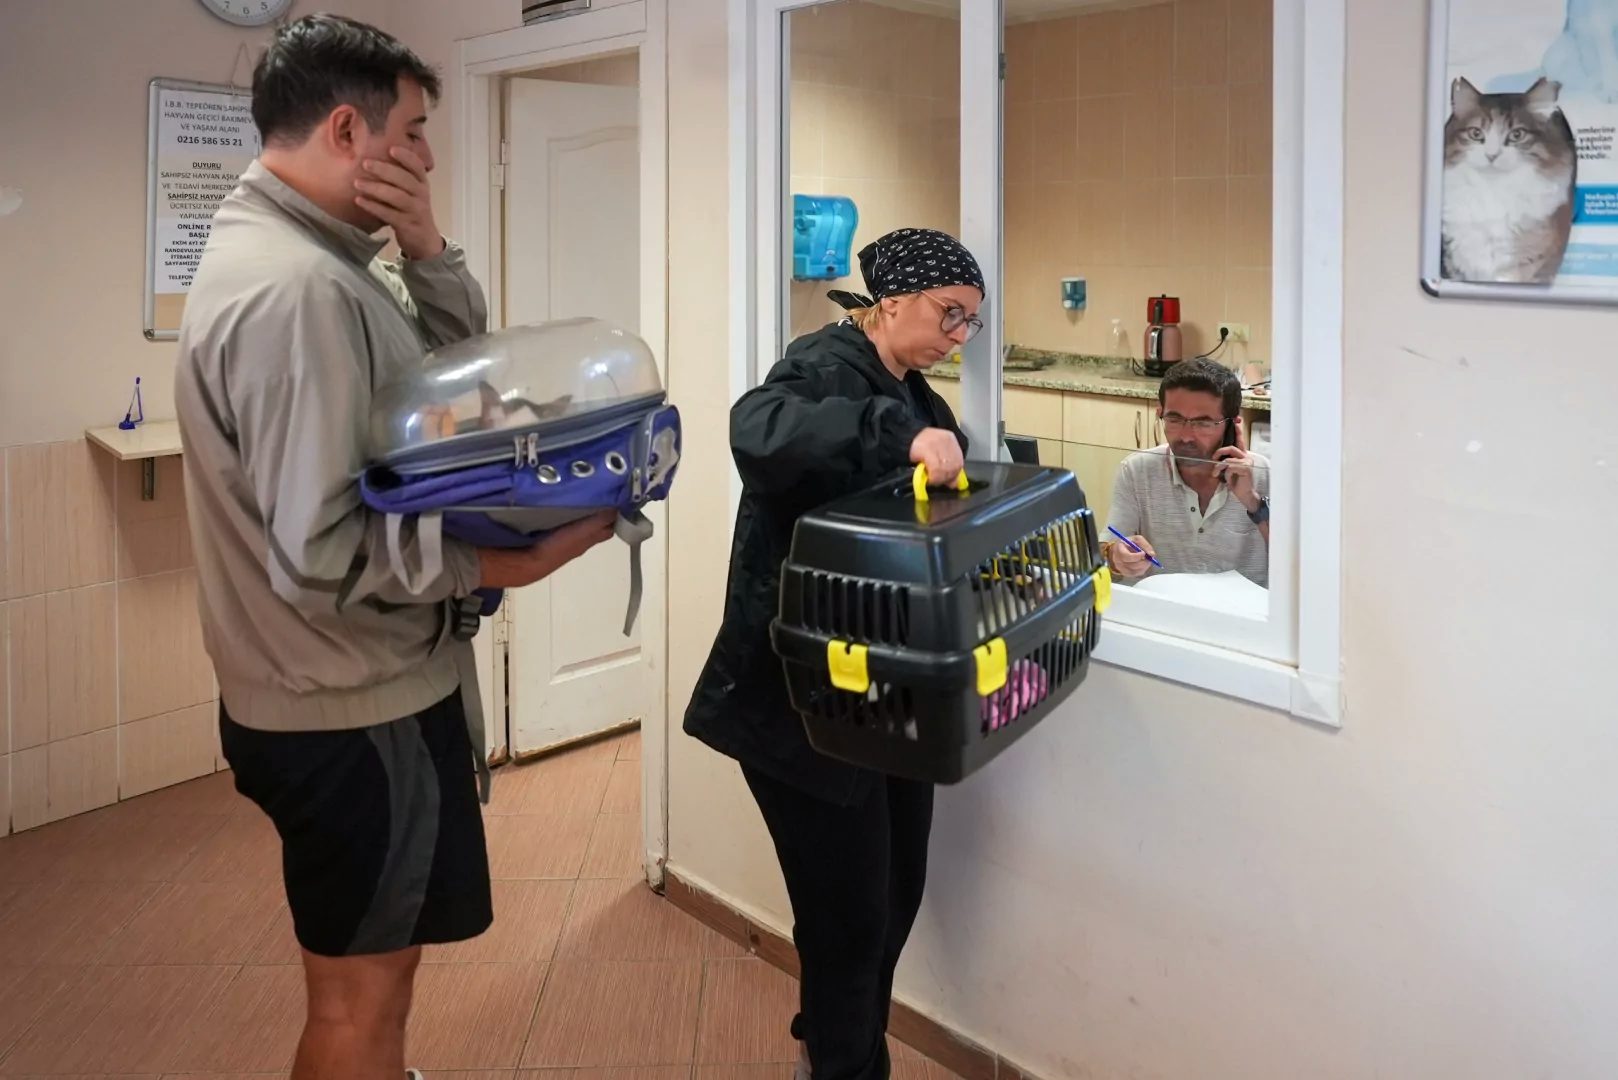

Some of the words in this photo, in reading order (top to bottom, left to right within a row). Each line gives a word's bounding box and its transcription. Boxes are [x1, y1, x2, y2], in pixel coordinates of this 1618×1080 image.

[224, 0, 230, 8] 7
[261, 2, 268, 10] 5
[242, 7, 250, 15] 6
[164, 111, 195, 120] HAYVAN
[180, 123, 190, 131] VE
[191, 123, 217, 132] YAŞAM
[177, 135, 200, 144] 0216
[201, 136, 218, 145] 586
[219, 138, 230, 146] 55
[232, 138, 243, 146] 21
[192, 161, 221, 169] DUYURU
[192, 172, 220, 180] HAYVAN
[161, 182, 171, 190] VE
[179, 212, 214, 220] YAPILMAK
[177, 222, 205, 230] ONLİNE
